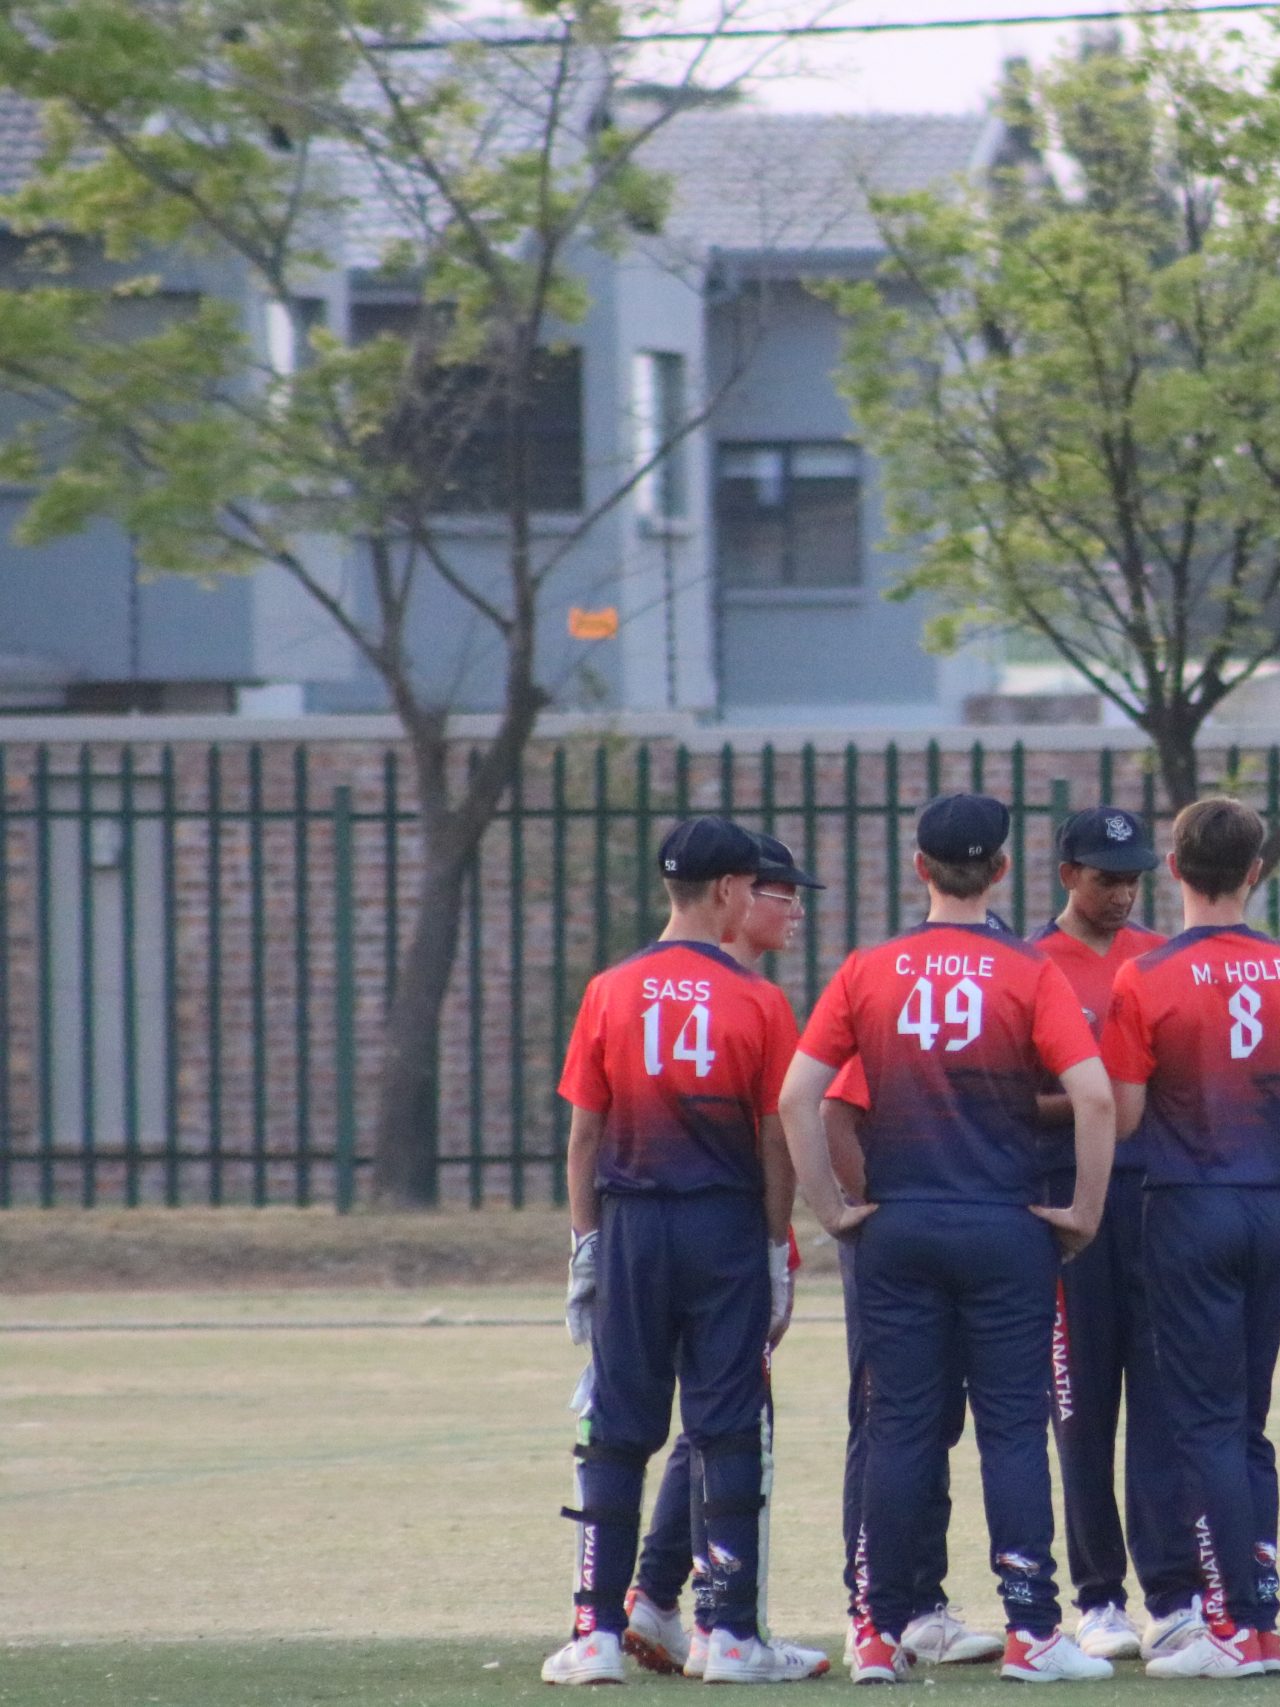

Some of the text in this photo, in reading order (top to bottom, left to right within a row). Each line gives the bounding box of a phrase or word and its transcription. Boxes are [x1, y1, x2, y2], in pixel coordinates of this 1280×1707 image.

[665, 859, 677, 871] 52
[642, 977, 711, 1002] SASS
[895, 953, 995, 978] C. HOLE
[1191, 962, 1219, 986] M.
[896, 976, 983, 1052] 49
[1228, 983, 1264, 1060] 8
[640, 1001, 717, 1078] 14
[1052, 1300, 1075, 1422] RANATHA
